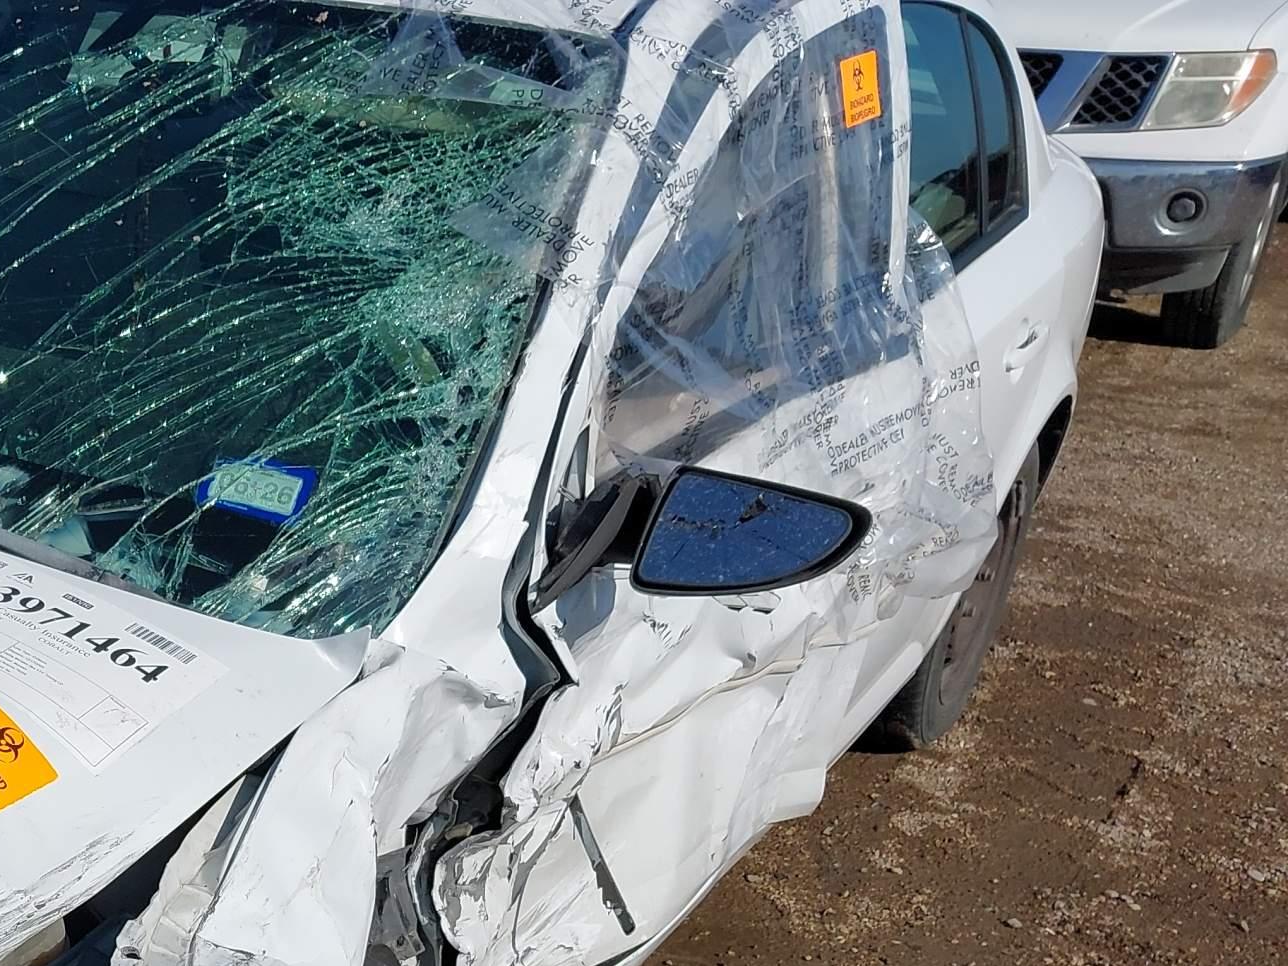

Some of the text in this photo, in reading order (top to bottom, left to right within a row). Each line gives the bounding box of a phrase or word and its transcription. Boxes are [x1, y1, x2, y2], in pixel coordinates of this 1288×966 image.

[666, 167, 699, 199] DEALER
[481, 193, 568, 252] DEALER MU
[495, 182, 579, 240] PROTECTIVE
[261, 482, 294, 505] 26
[38, 637, 71, 656] COBALT
[41, 629, 91, 657] Insurance
